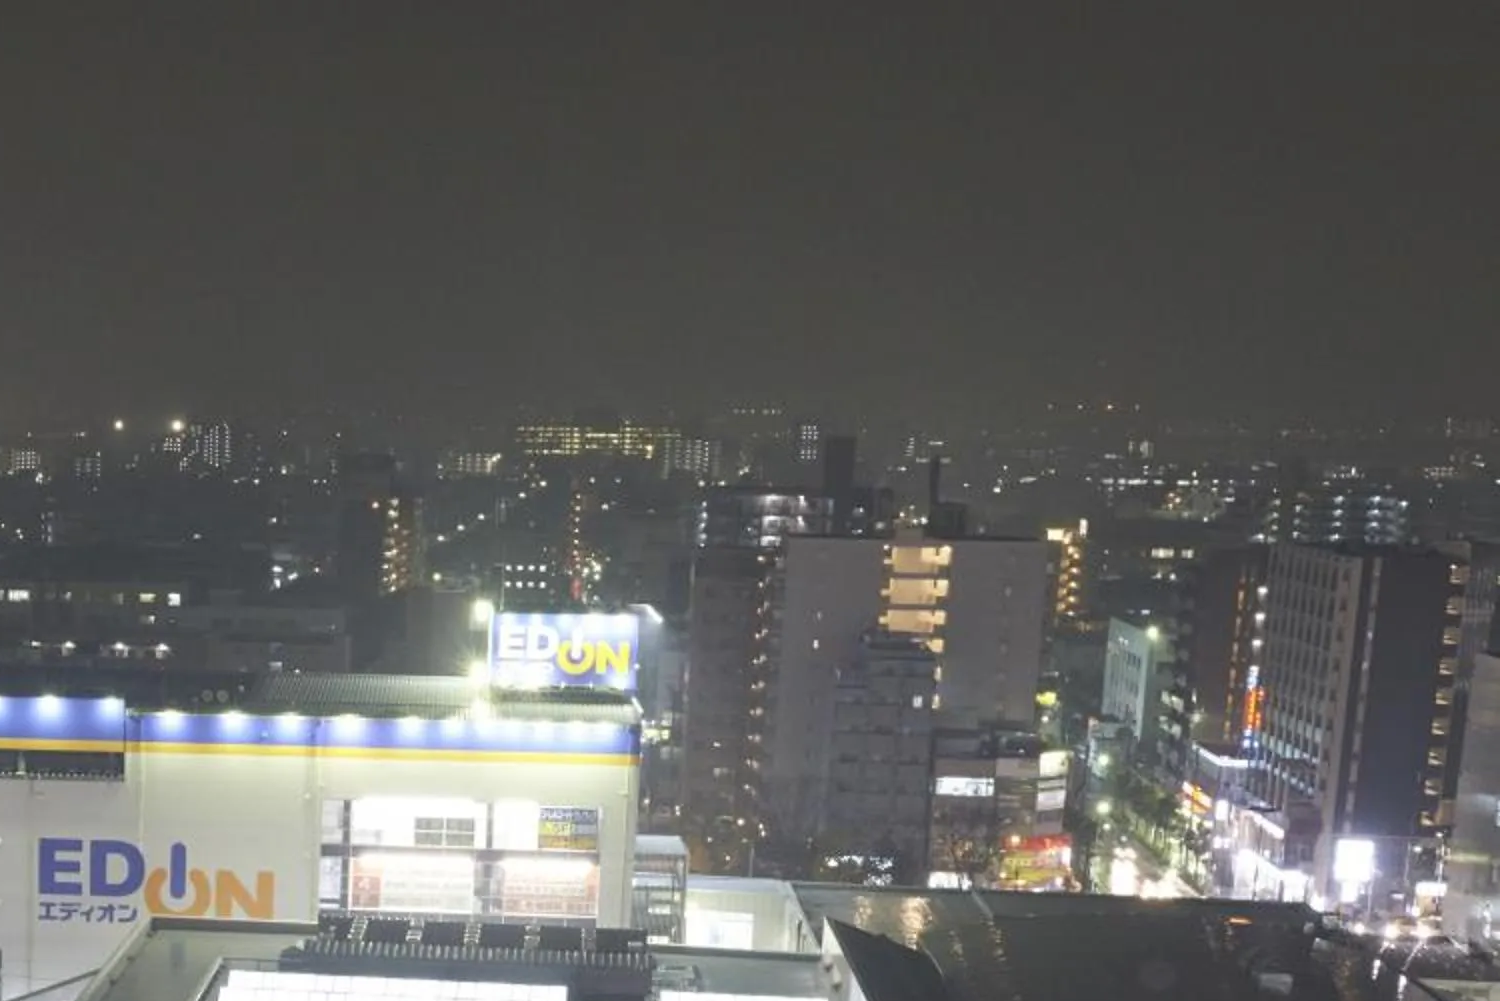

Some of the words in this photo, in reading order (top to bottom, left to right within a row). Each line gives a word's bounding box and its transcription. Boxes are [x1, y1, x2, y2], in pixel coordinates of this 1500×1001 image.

[498, 624, 631, 676] EDION
[38, 838, 274, 919] EDION
[38, 902, 138, 923] エディオン
